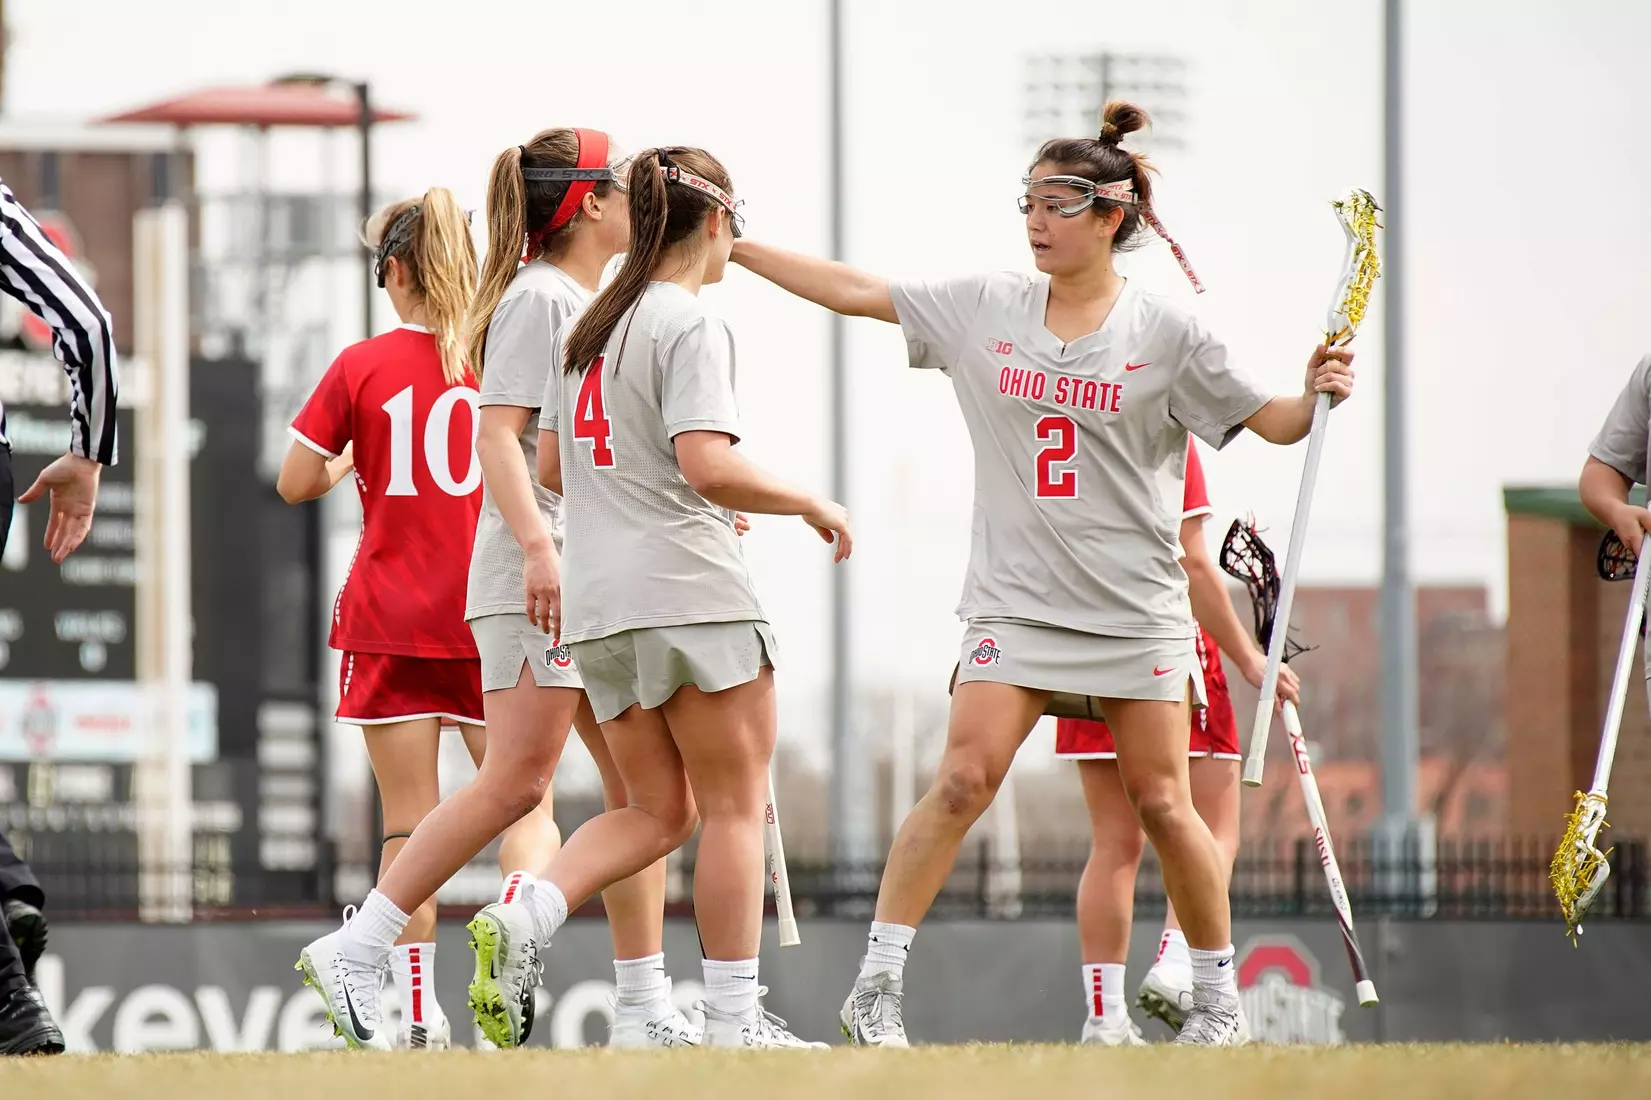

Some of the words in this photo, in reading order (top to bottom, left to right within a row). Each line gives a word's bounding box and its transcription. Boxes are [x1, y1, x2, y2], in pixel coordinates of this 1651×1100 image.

[526, 170, 554, 178] PRO
[562, 169, 593, 179] STX
[690, 178, 710, 190] STX
[719, 192, 732, 206] STX
[573, 353, 616, 469] 4
[999, 366, 1047, 401] OHIO
[1054, 376, 1123, 413] STATE
[381, 385, 482, 497] 10
[1034, 414, 1079, 500] 2
